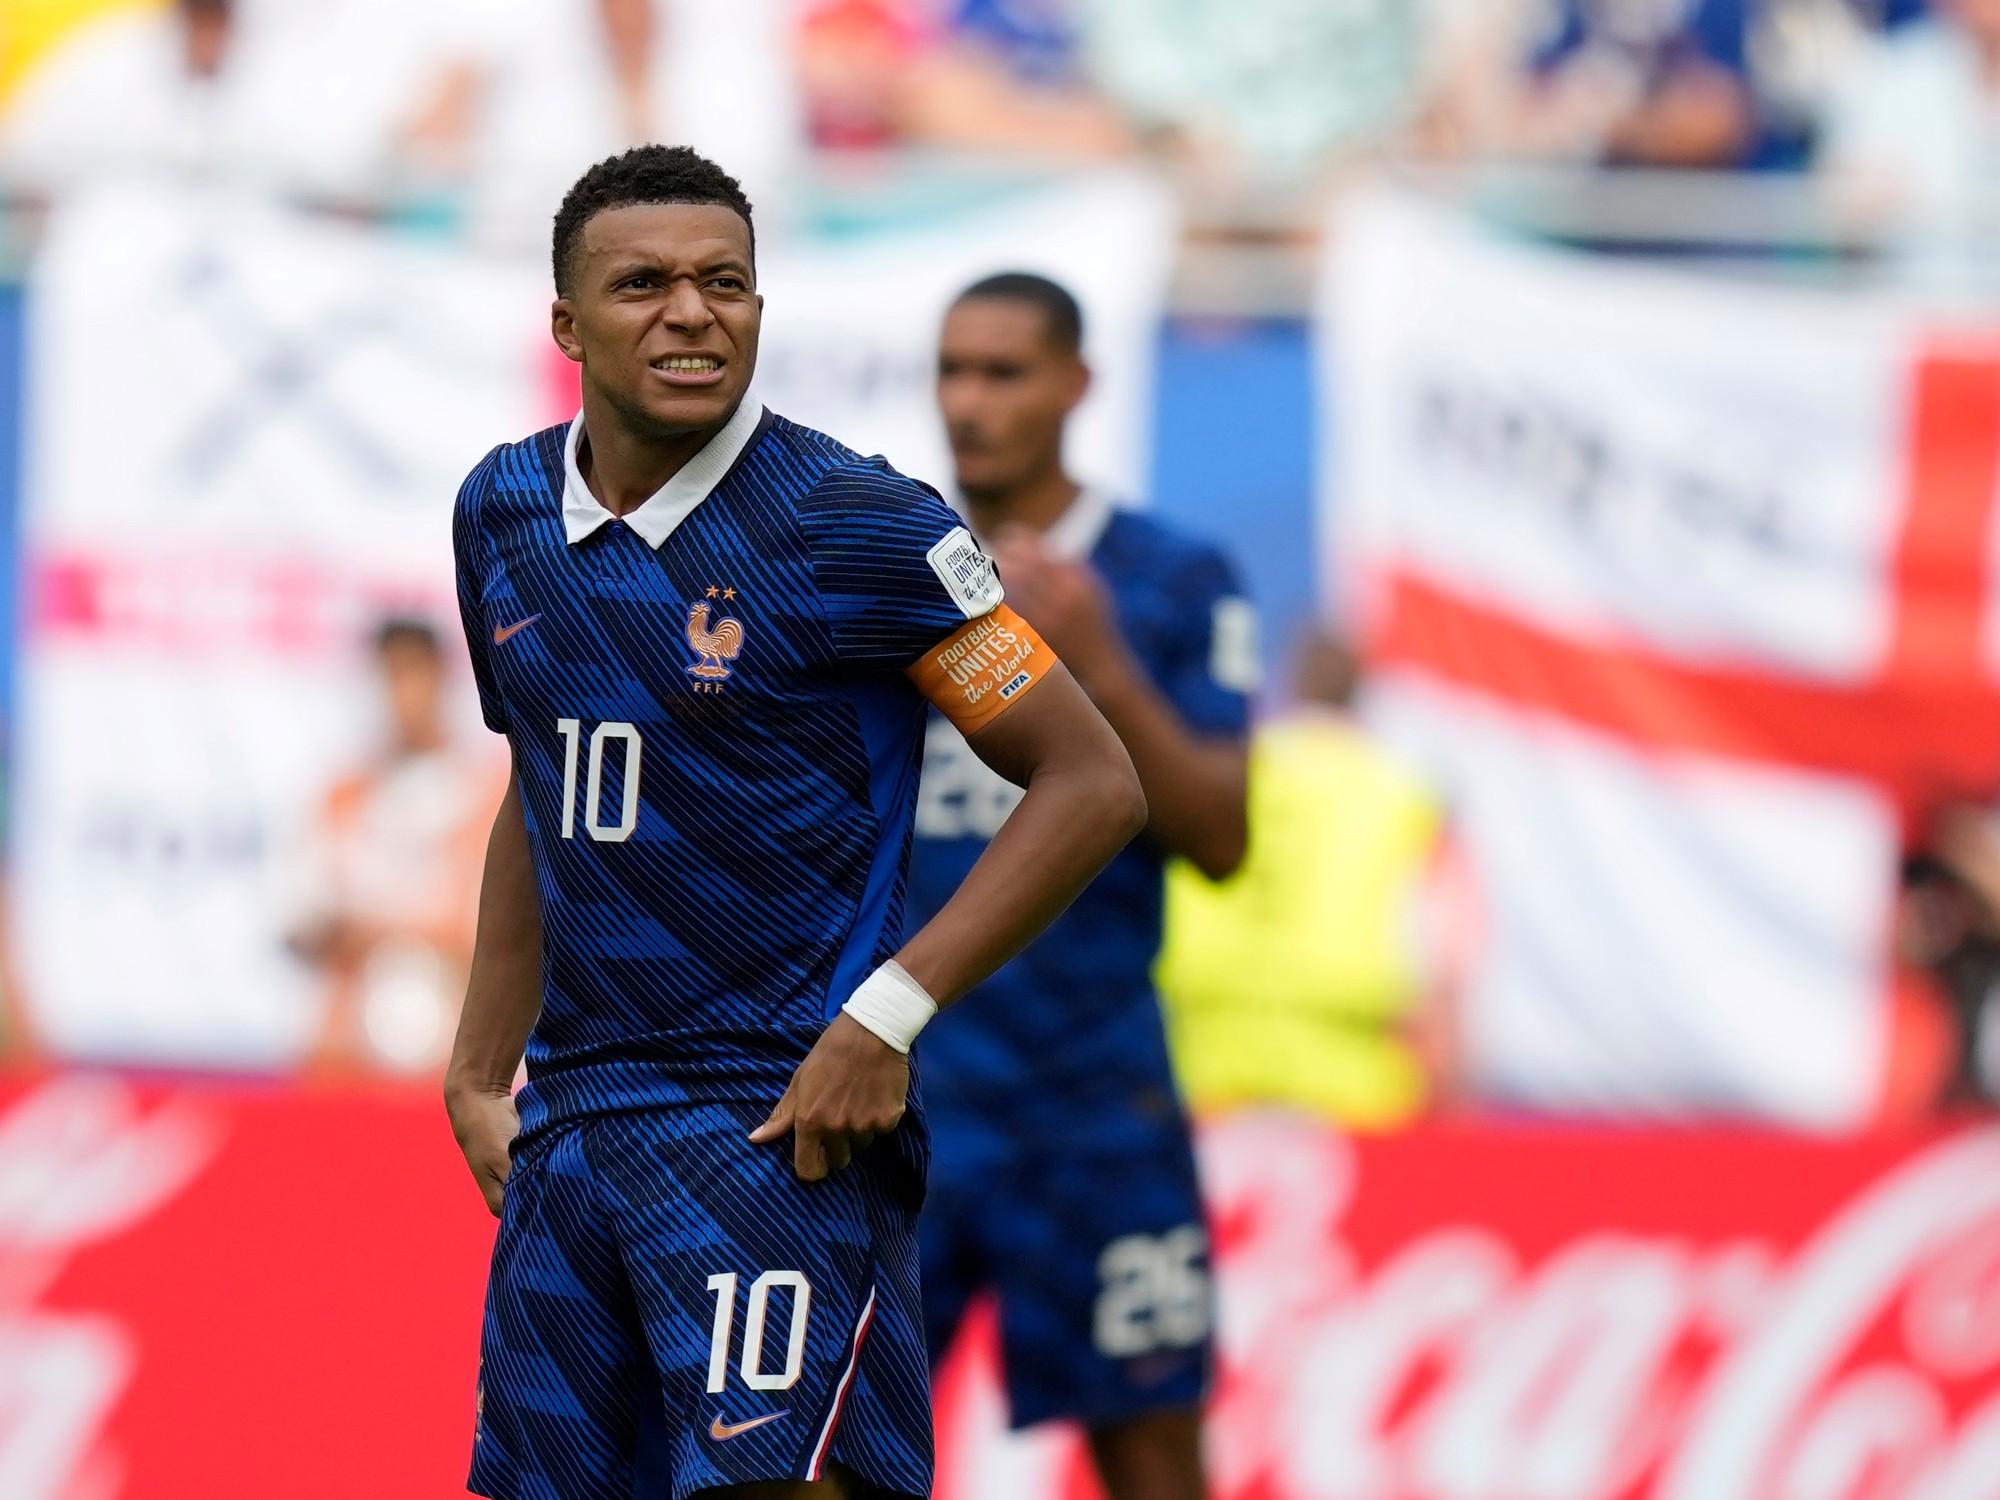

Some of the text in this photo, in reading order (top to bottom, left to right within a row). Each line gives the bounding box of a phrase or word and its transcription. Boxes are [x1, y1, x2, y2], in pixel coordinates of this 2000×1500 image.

[953, 551, 986, 584] UNITES
[936, 615, 1000, 670] FOOTBALL
[947, 626, 1017, 685] UNITES
[962, 636, 1035, 704] the World
[693, 682, 724, 694] FFF
[1002, 674, 1029, 697] FIFA
[557, 718, 641, 842] 10
[1094, 1223, 1207, 1347] 26
[706, 1269, 811, 1393] 10
